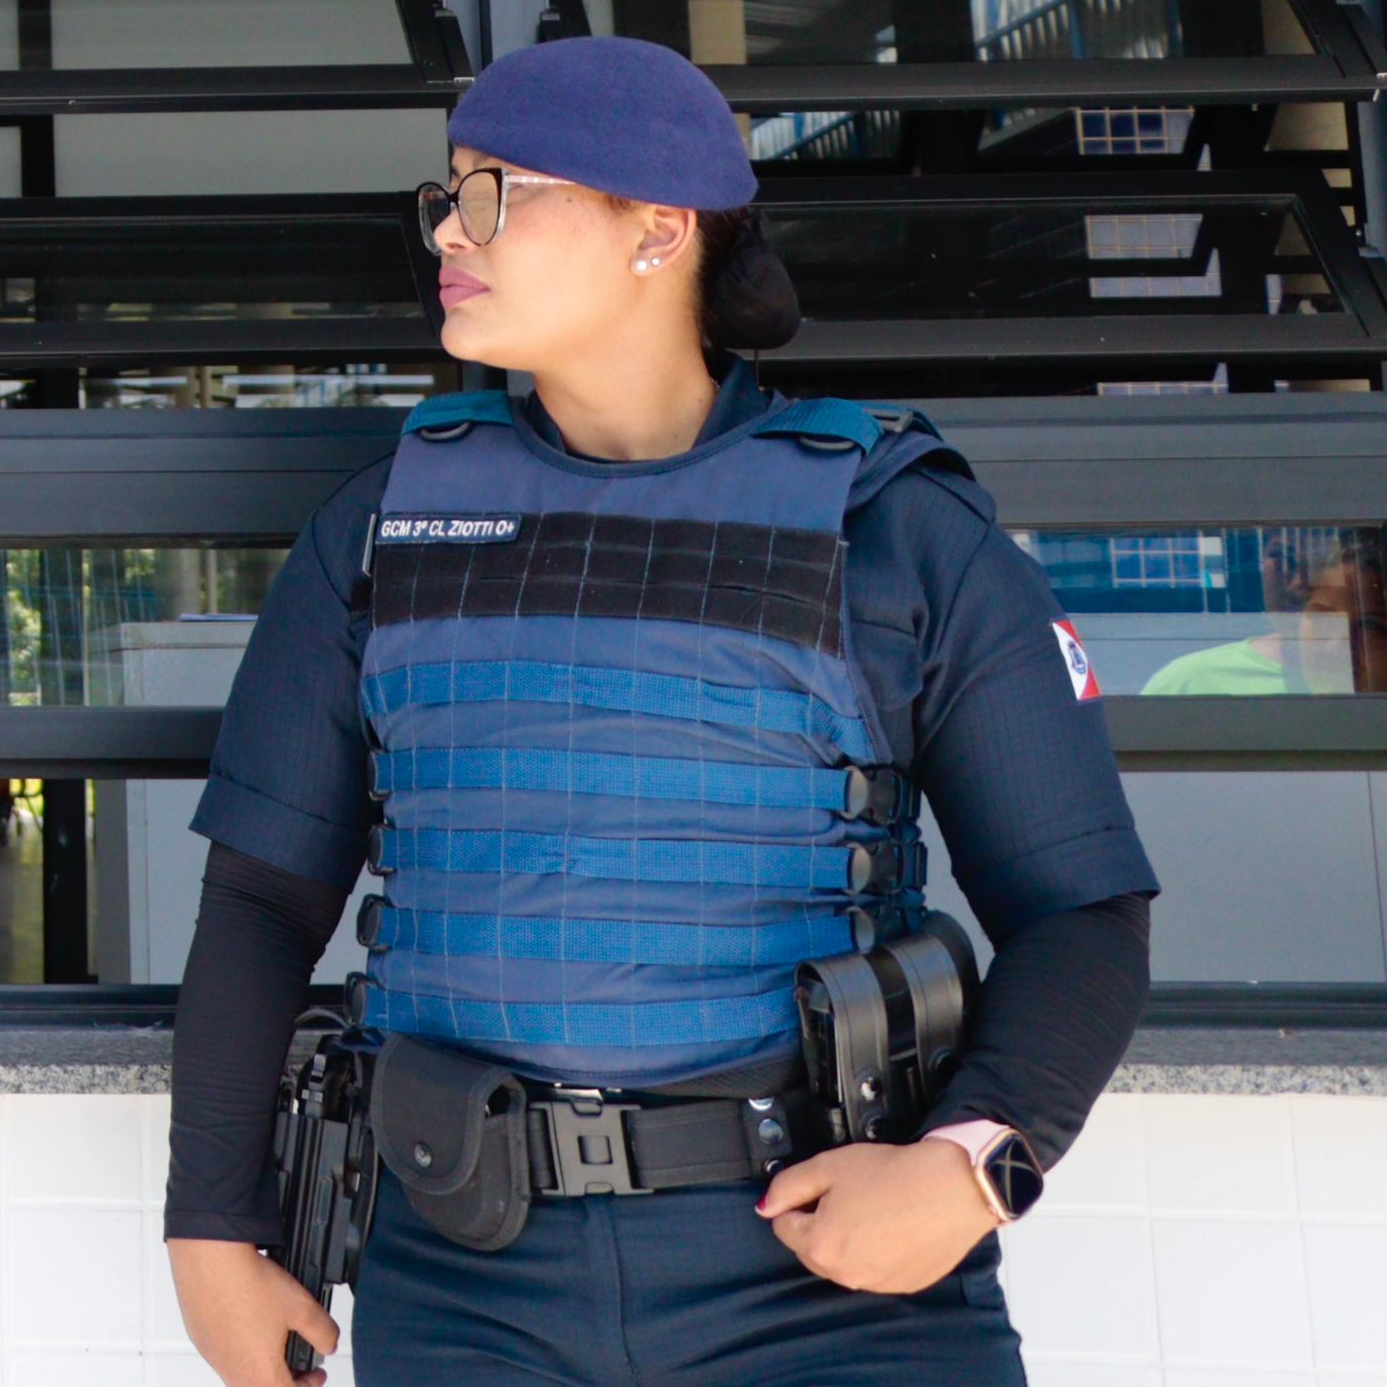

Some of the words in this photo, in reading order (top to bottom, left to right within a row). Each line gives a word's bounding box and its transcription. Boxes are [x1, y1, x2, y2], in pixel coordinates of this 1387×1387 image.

[381, 520, 411, 537] GCM
[428, 520, 445, 536] CL
[447, 520, 494, 536] ZIOTTI
